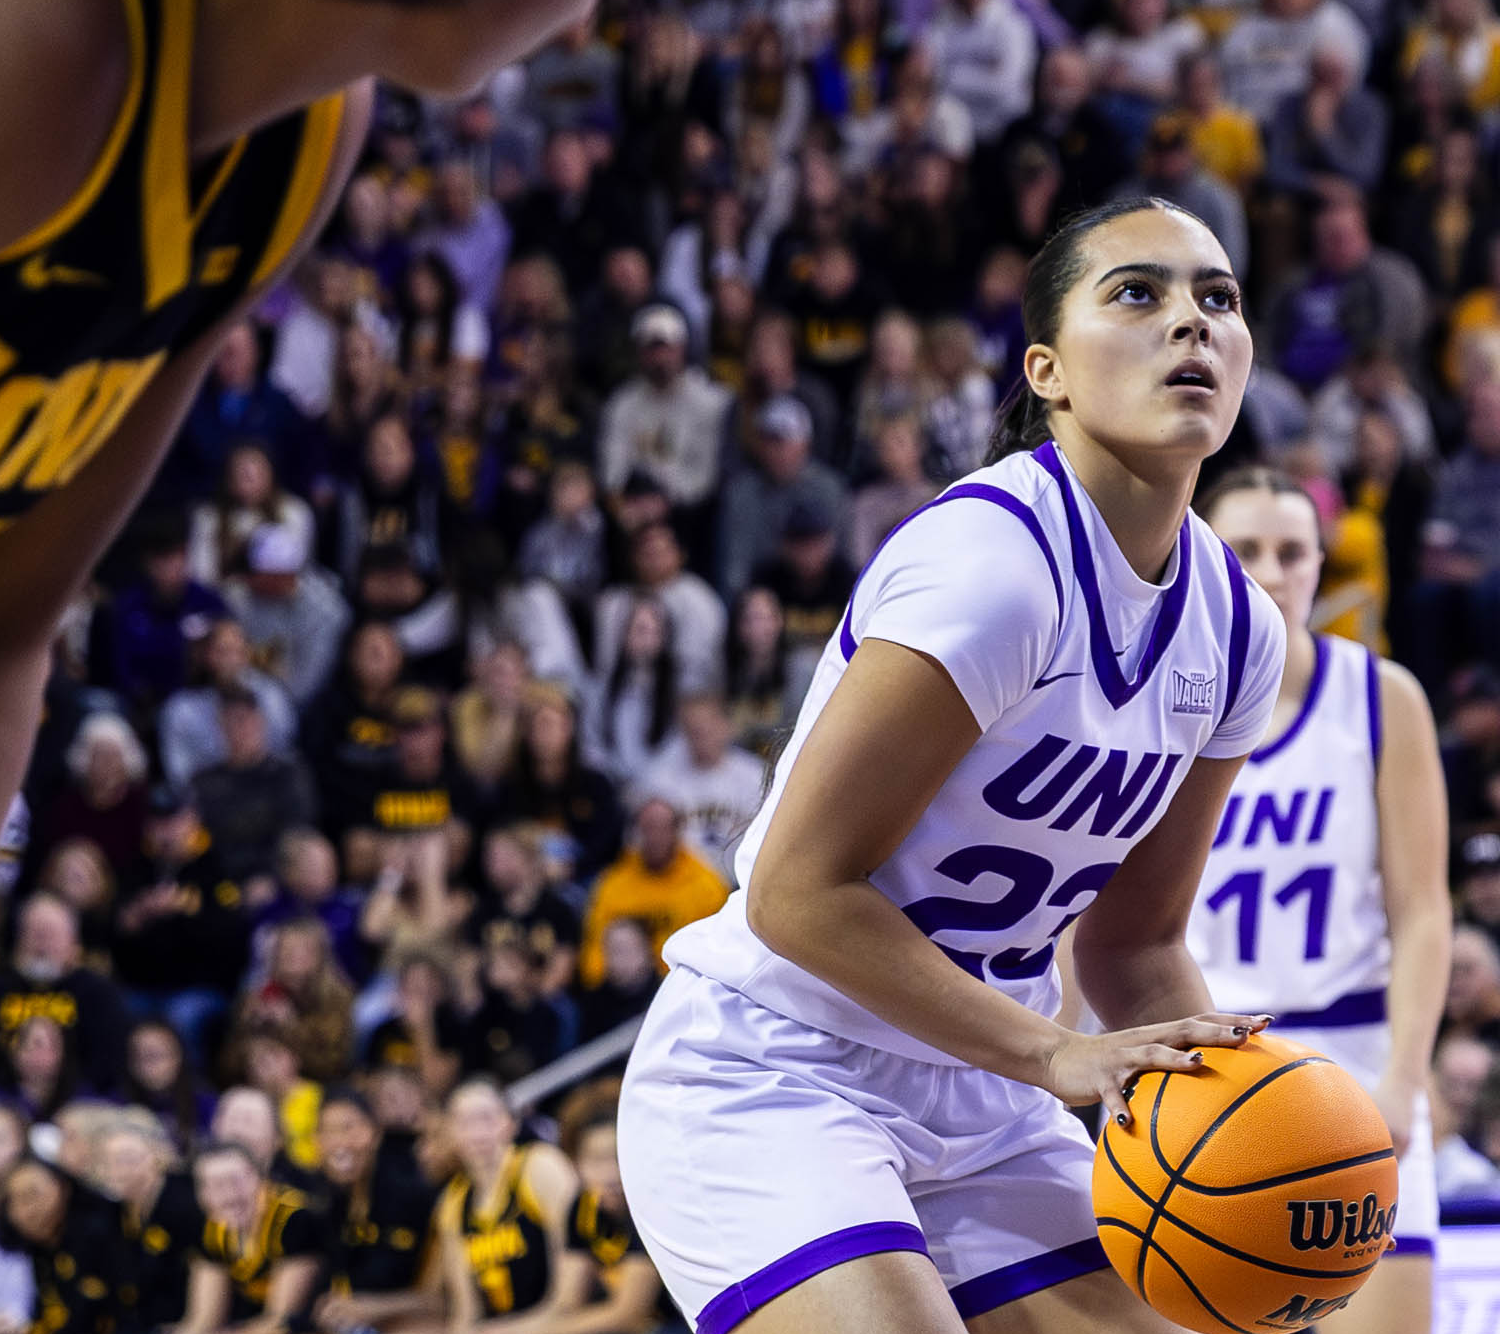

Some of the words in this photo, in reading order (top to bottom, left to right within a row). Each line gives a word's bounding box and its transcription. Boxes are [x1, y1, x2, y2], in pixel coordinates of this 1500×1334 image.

[1173, 670, 1215, 708] VALLE
[983, 733, 1183, 839] UNI
[1207, 865, 1335, 964] 11
[1287, 1193, 1397, 1251] Wilso
